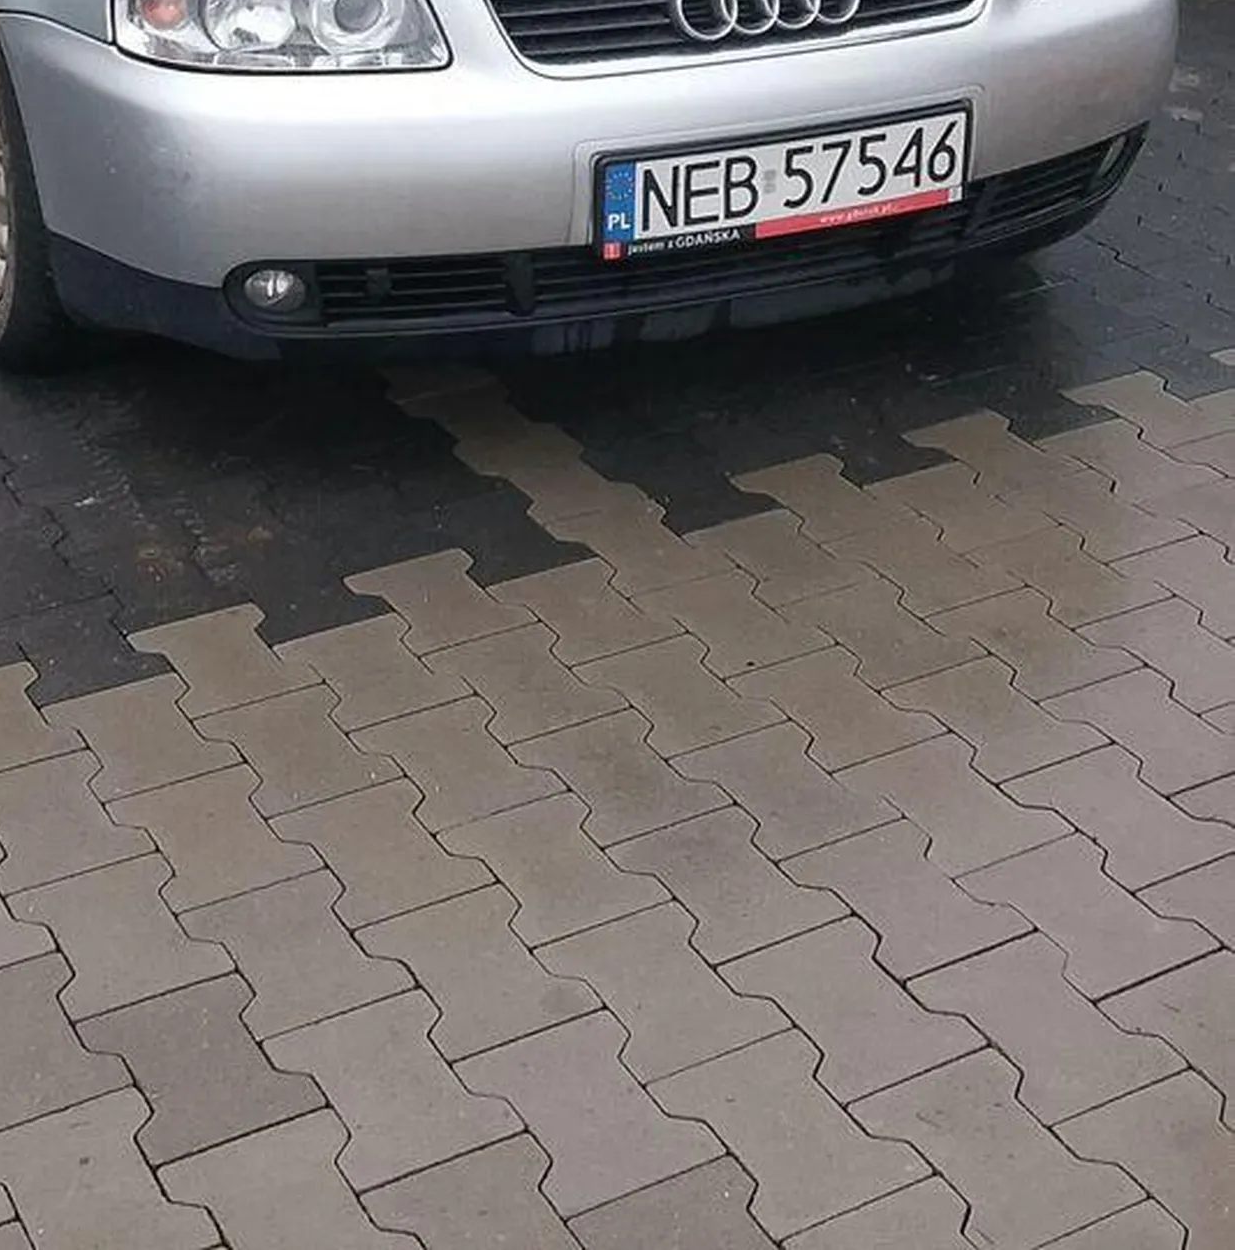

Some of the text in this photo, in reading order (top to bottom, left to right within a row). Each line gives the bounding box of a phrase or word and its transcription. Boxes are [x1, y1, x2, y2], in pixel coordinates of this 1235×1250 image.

[642, 121, 959, 232] NEB 57546
[608, 213, 631, 231] PL
